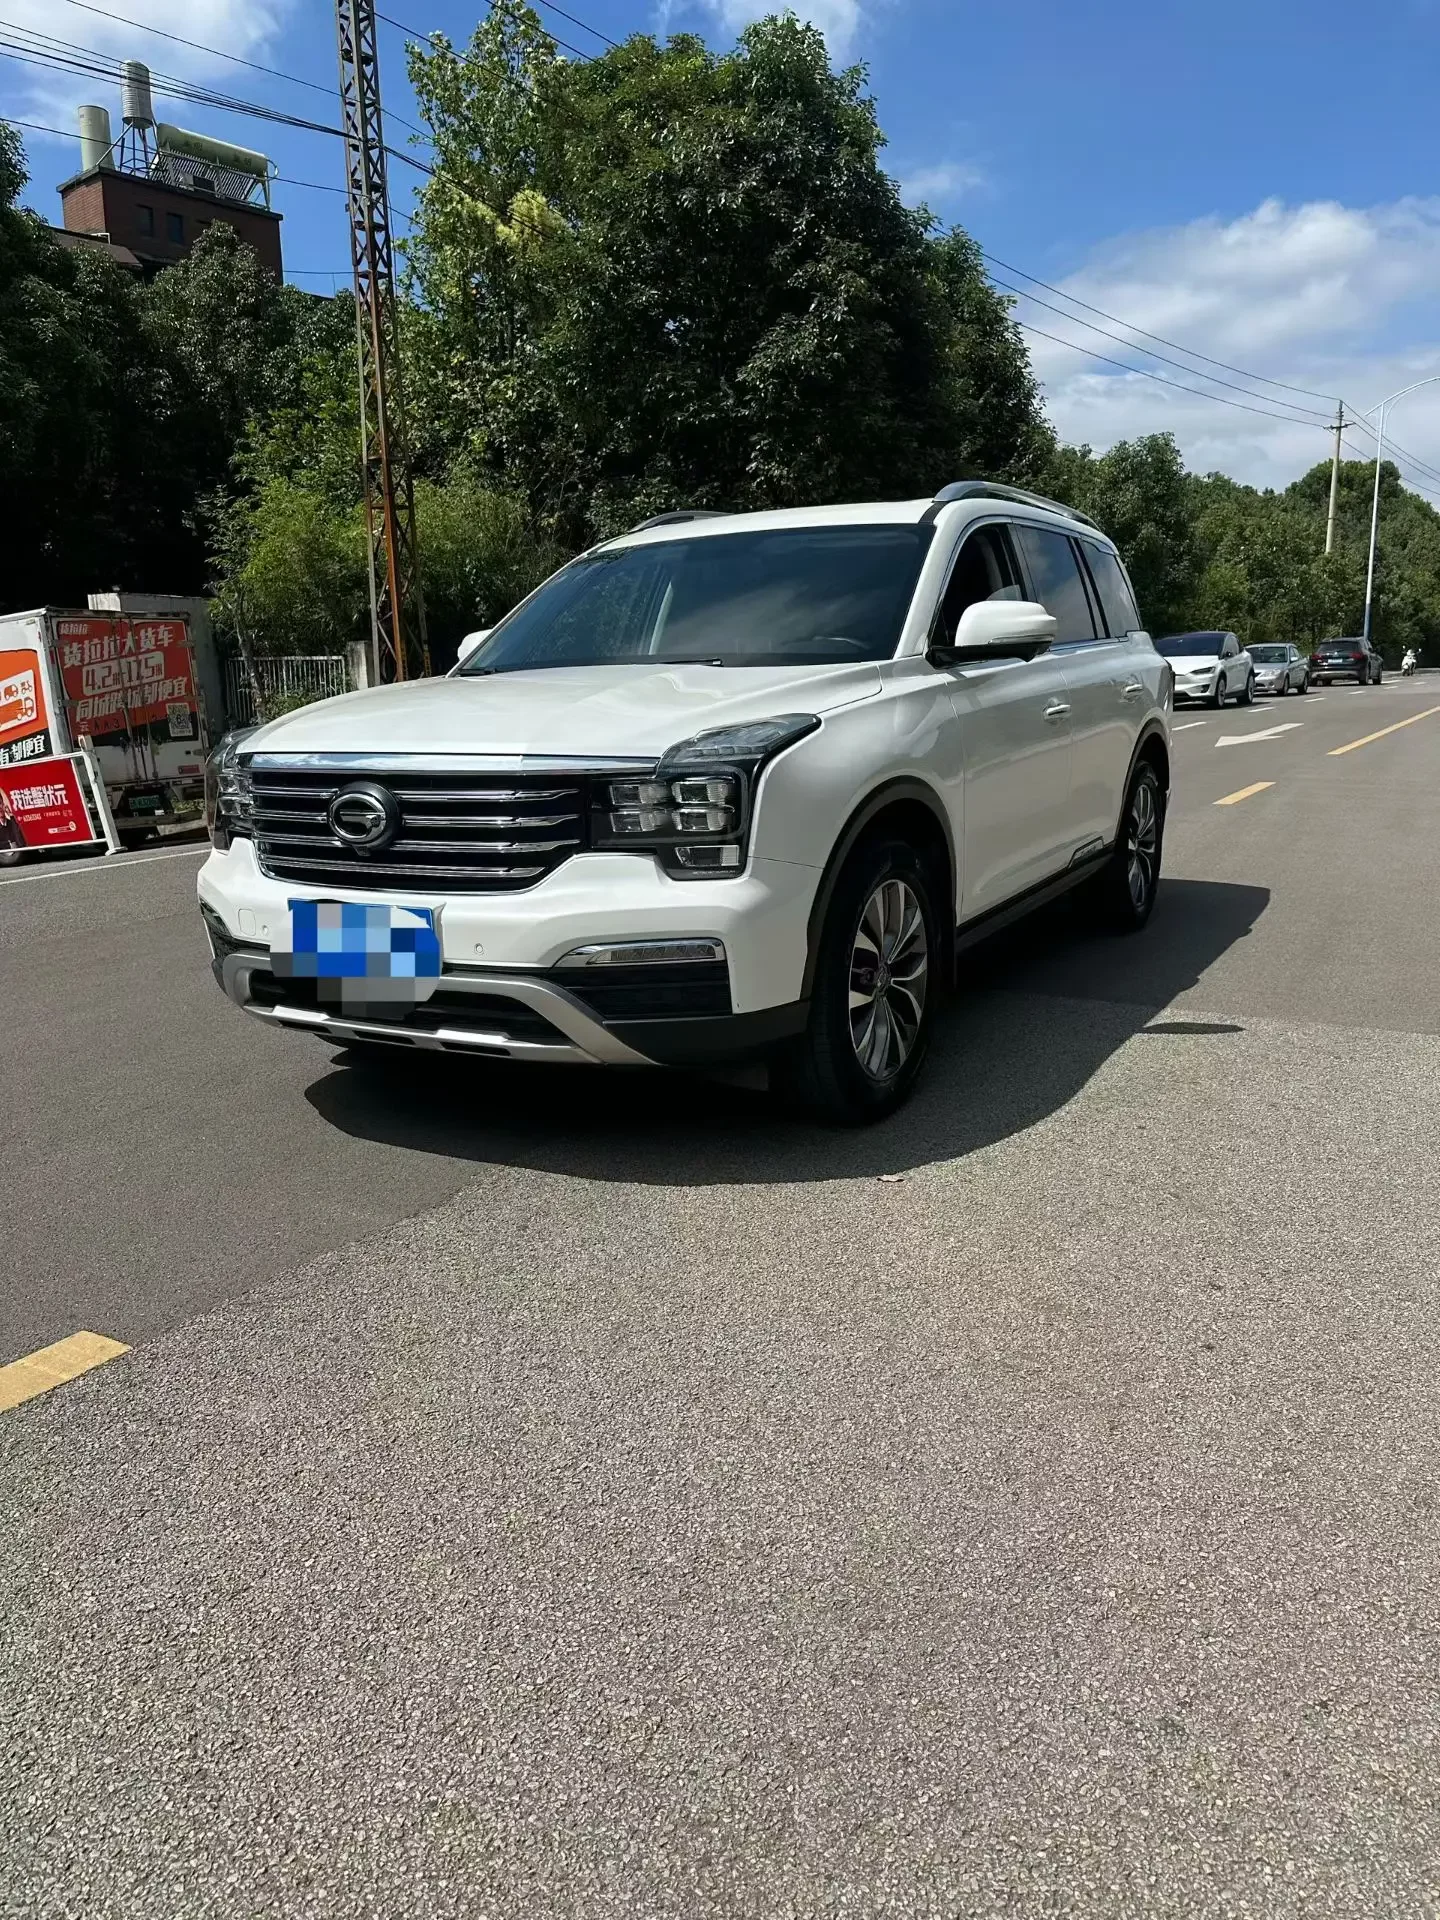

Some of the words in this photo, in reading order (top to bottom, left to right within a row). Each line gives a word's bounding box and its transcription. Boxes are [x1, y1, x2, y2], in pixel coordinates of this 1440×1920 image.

[63, 625, 174, 668] 货拉拉大货车
